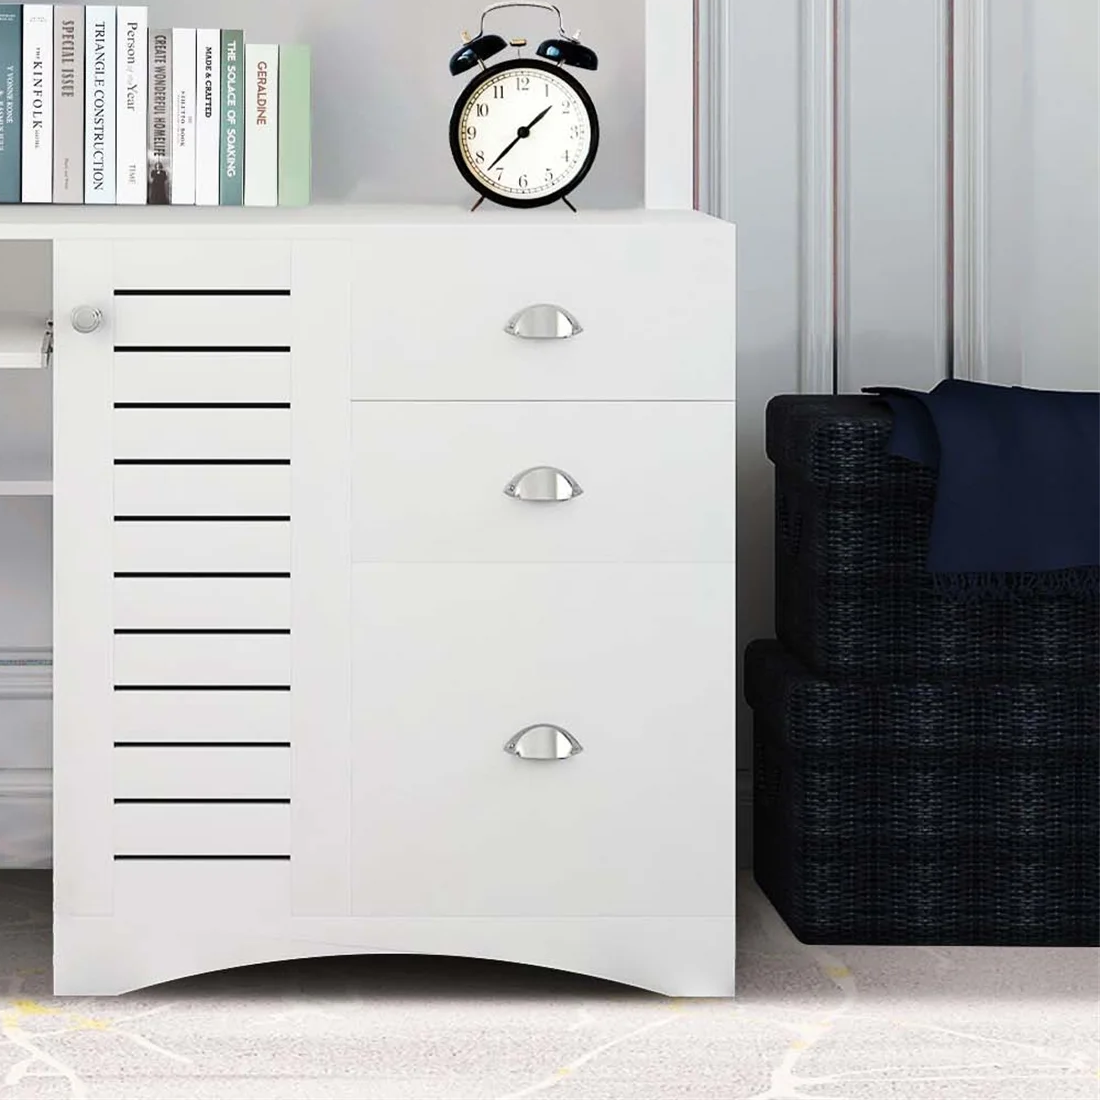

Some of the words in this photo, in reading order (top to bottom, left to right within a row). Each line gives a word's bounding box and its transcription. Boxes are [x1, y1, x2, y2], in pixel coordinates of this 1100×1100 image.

[61, 20, 74, 64] SPECIAL
[94, 21, 105, 87] TRIANGLE
[127, 22, 138, 64] Person
[154, 35, 166, 63] CREATE
[227, 41, 236, 62] THE
[32, 61, 43, 129] KINFOLK
[61, 69, 74, 98] ISSUE
[154, 65, 166, 115] WONDERFUL
[227, 66, 236, 106] SOLACE
[256, 61, 267, 126] GERALDINE
[493, 86, 504, 99] 11
[516, 77, 530, 91] 12
[544, 84, 549, 97] 1
[127, 84, 137, 112] Year
[562, 101, 570, 114] 2
[227, 110, 236, 125] OF
[476, 104, 489, 117] 10
[93, 89, 105, 191] CONSTRUCTION
[153, 117, 166, 156] HOMELIFE
[467, 126, 476, 140] 9
[226, 129, 236, 177] SOAKING
[475, 151, 485, 164] 8
[128, 164, 136, 185] TIME
[496, 167, 504, 180] 7
[518, 175, 528, 188] 6
[544, 168, 553, 182] 5
